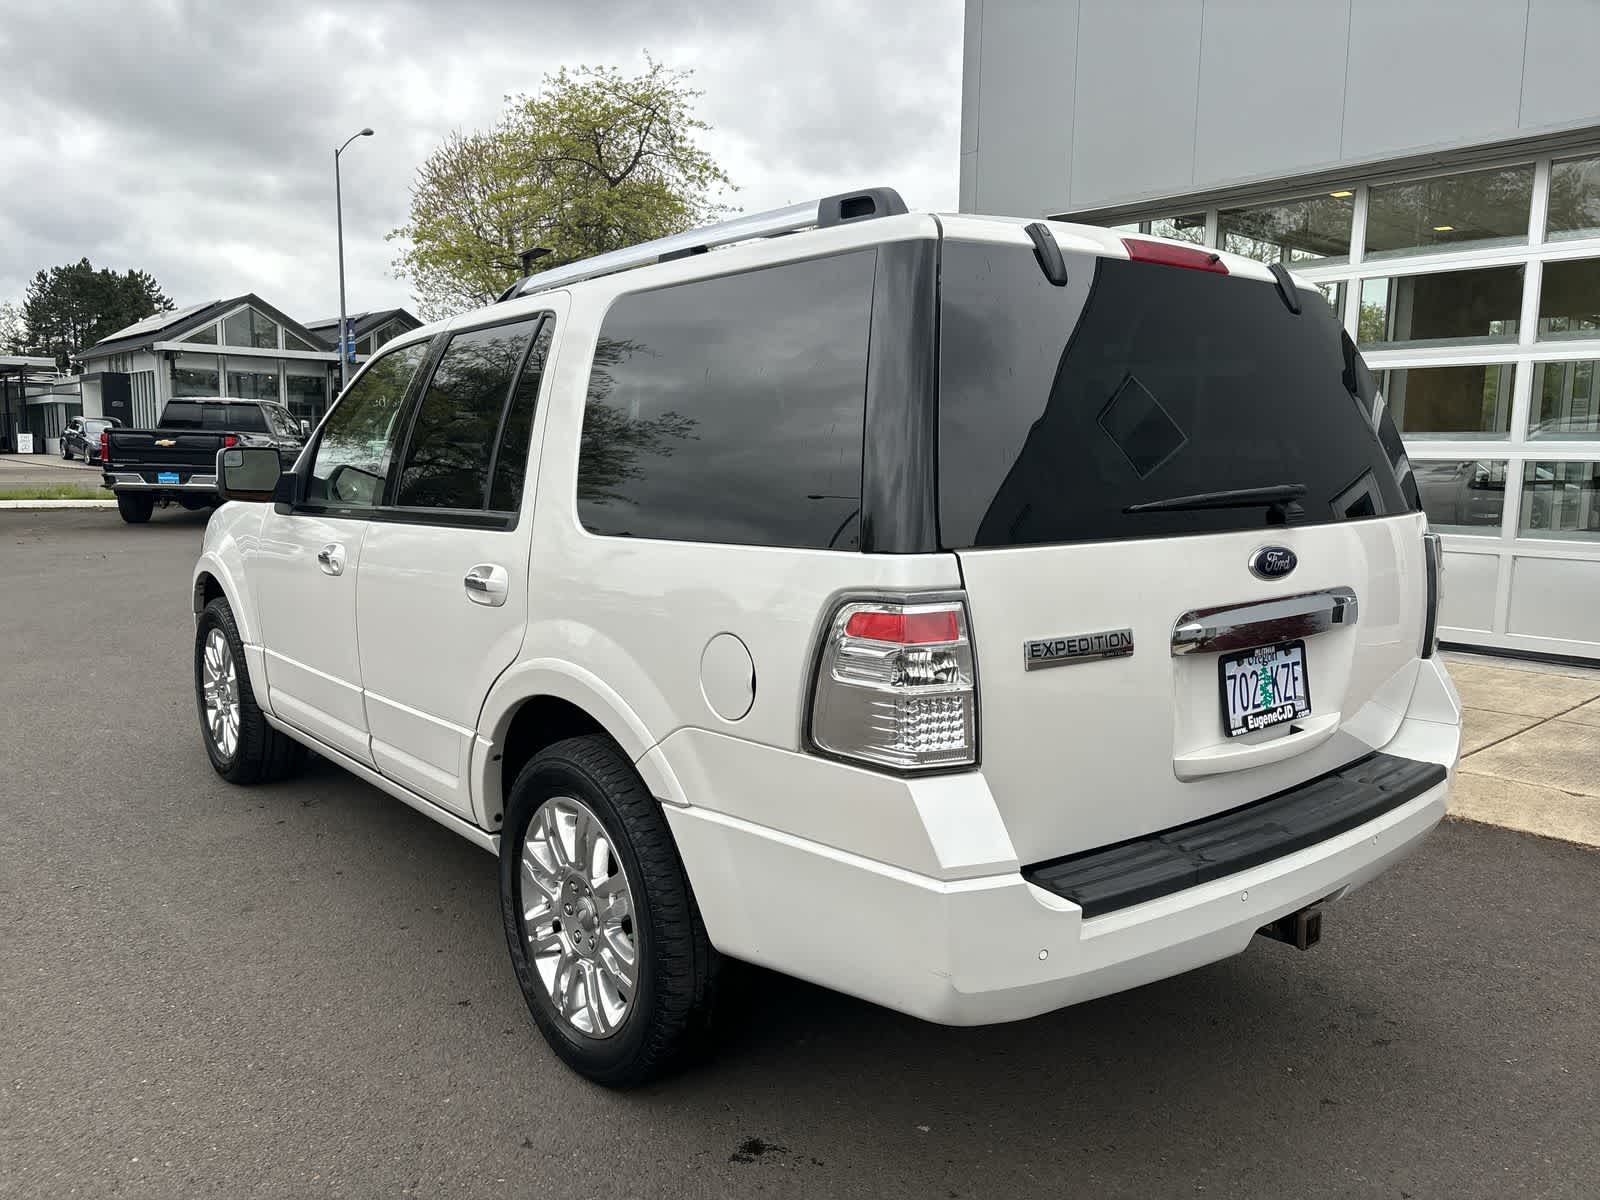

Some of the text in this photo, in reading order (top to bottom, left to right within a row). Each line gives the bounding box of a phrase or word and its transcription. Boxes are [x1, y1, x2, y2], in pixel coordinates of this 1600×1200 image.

[1265, 551, 1290, 571] Ford
[1030, 631, 1132, 658] EXPEDITION
[1247, 652, 1278, 667] Oregon
[1227, 661, 1300, 714] 702 KZF
[1247, 704, 1294, 729] EugeneCJD
